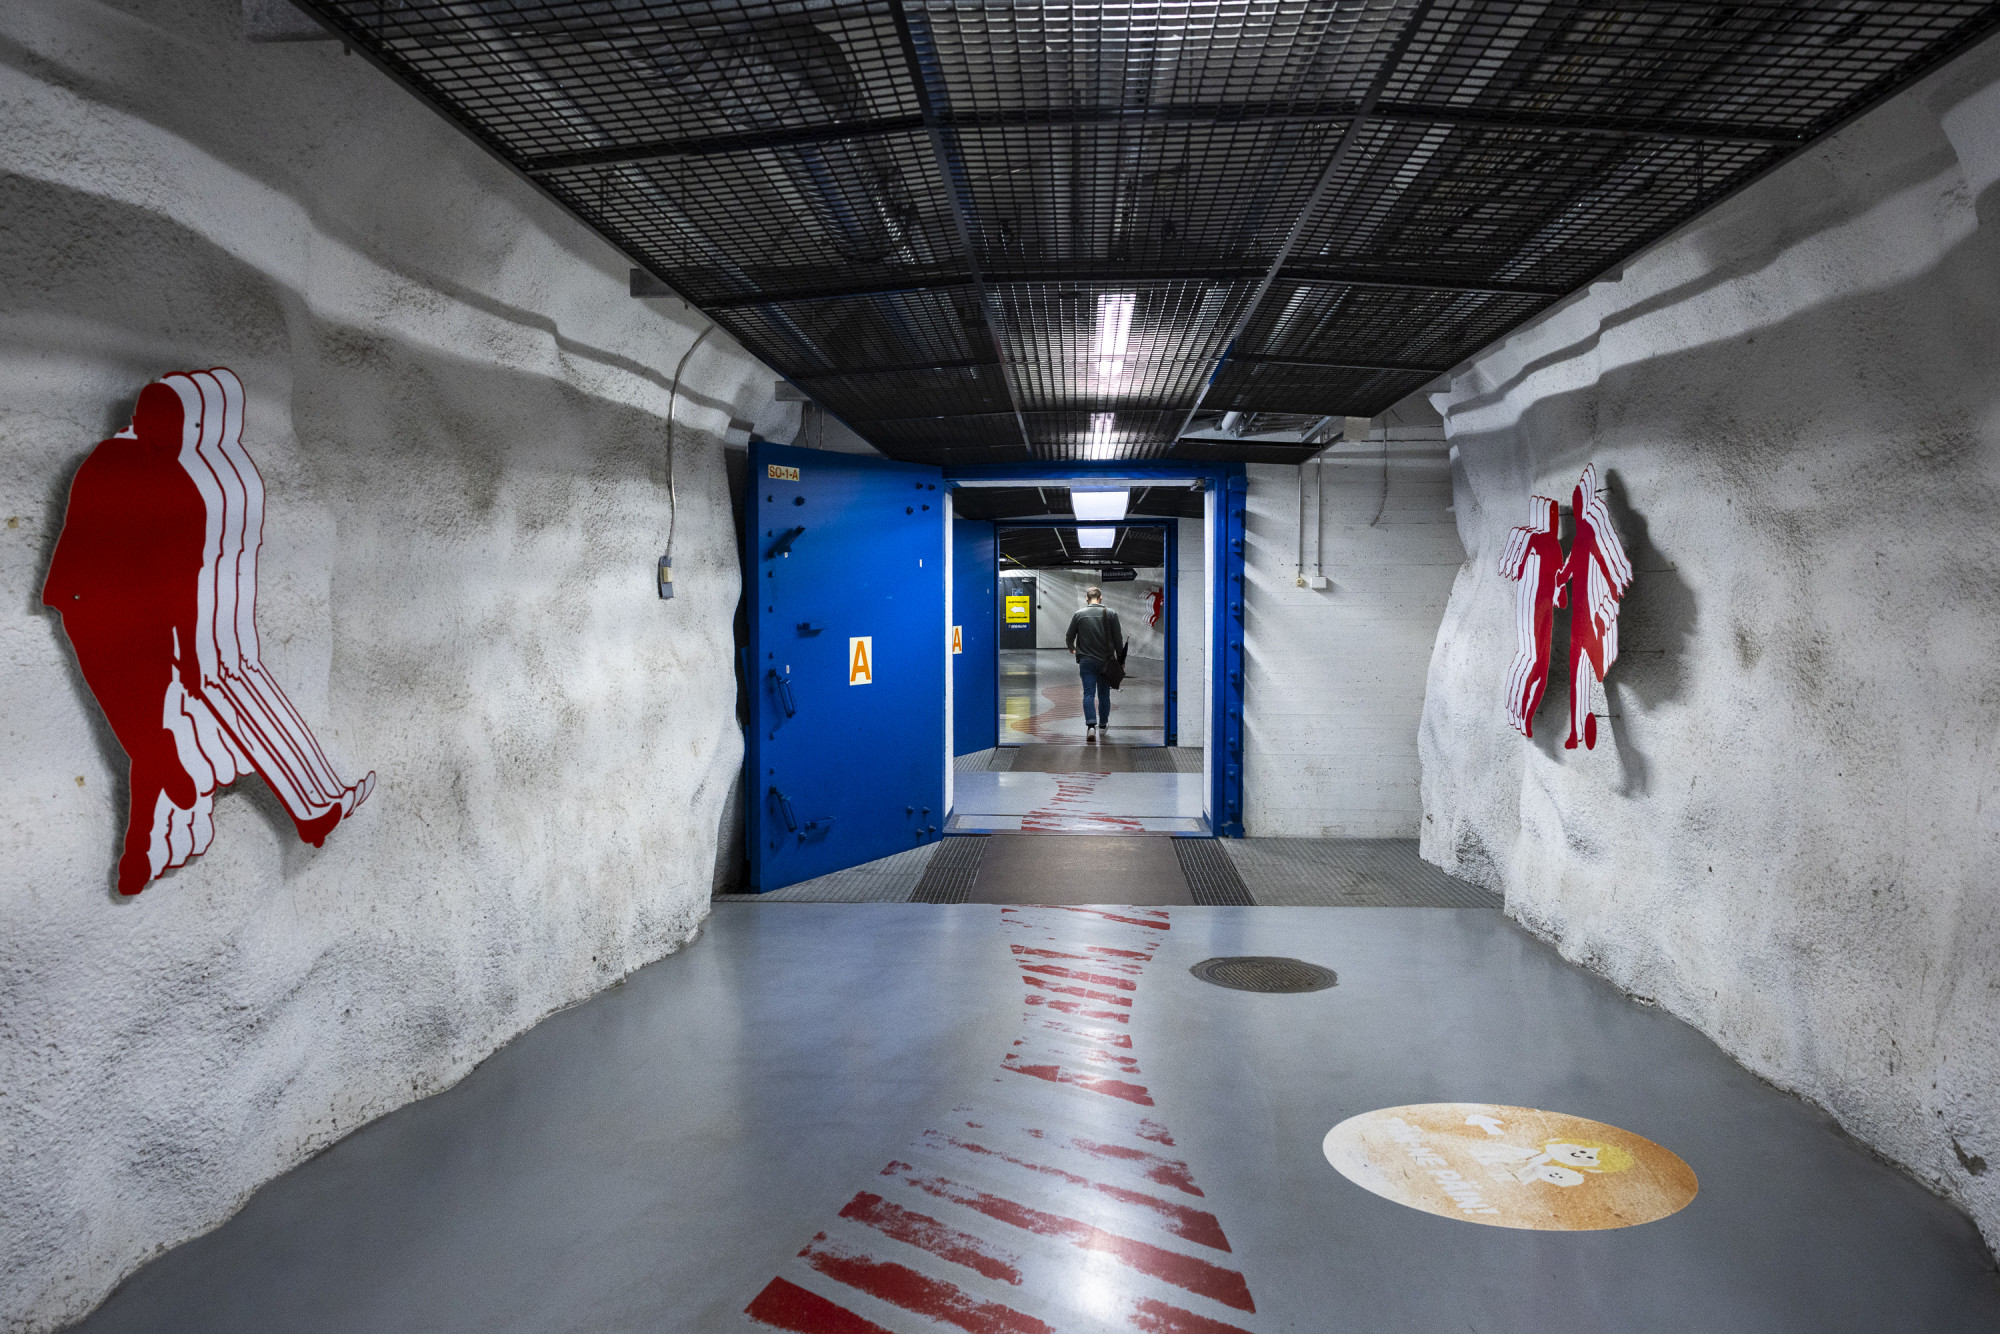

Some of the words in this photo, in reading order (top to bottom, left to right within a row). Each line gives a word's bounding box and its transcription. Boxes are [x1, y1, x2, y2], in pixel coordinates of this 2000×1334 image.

[769, 465, 799, 481] SO-1-A
[952, 627, 962, 652] A
[850, 640, 872, 682] A
[1427, 1170, 1500, 1215] PÄIN!
